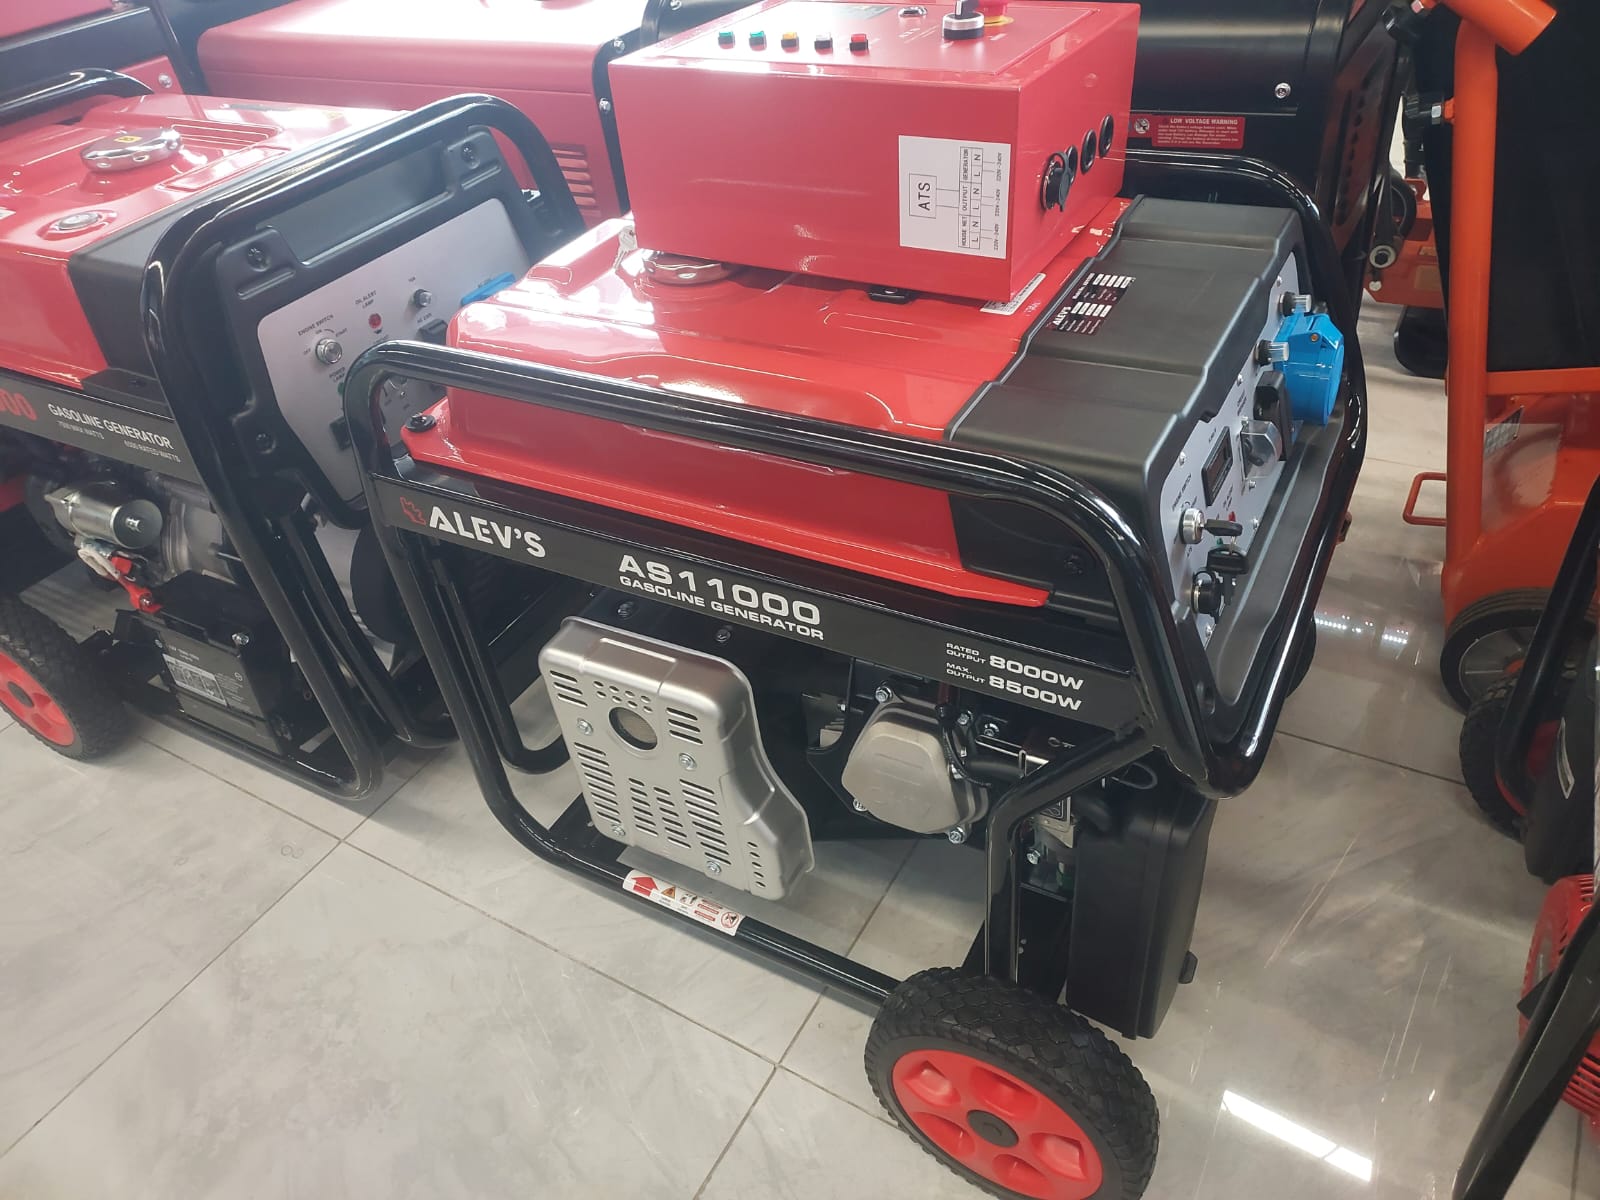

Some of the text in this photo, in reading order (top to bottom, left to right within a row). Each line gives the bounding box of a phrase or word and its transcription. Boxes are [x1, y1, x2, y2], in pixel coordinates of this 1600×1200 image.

[974, 153, 981, 161] N
[917, 182, 931, 212] ATS
[972, 187, 980, 195] N
[972, 220, 979, 228] N
[47, 403, 175, 450] GASOLINE GENERATOR
[429, 506, 546, 558] ALEV'S
[619, 554, 821, 626] AS11000
[619, 576, 825, 641] GASOLINE GENERATOR
[946, 642, 980, 656] RATED
[946, 649, 987, 664] OUTPUT
[946, 662, 972, 674] MAX.
[946, 668, 986, 684] OUTPUT
[989, 655, 1084, 691] 8000W
[988, 675, 1083, 711] 8500W
